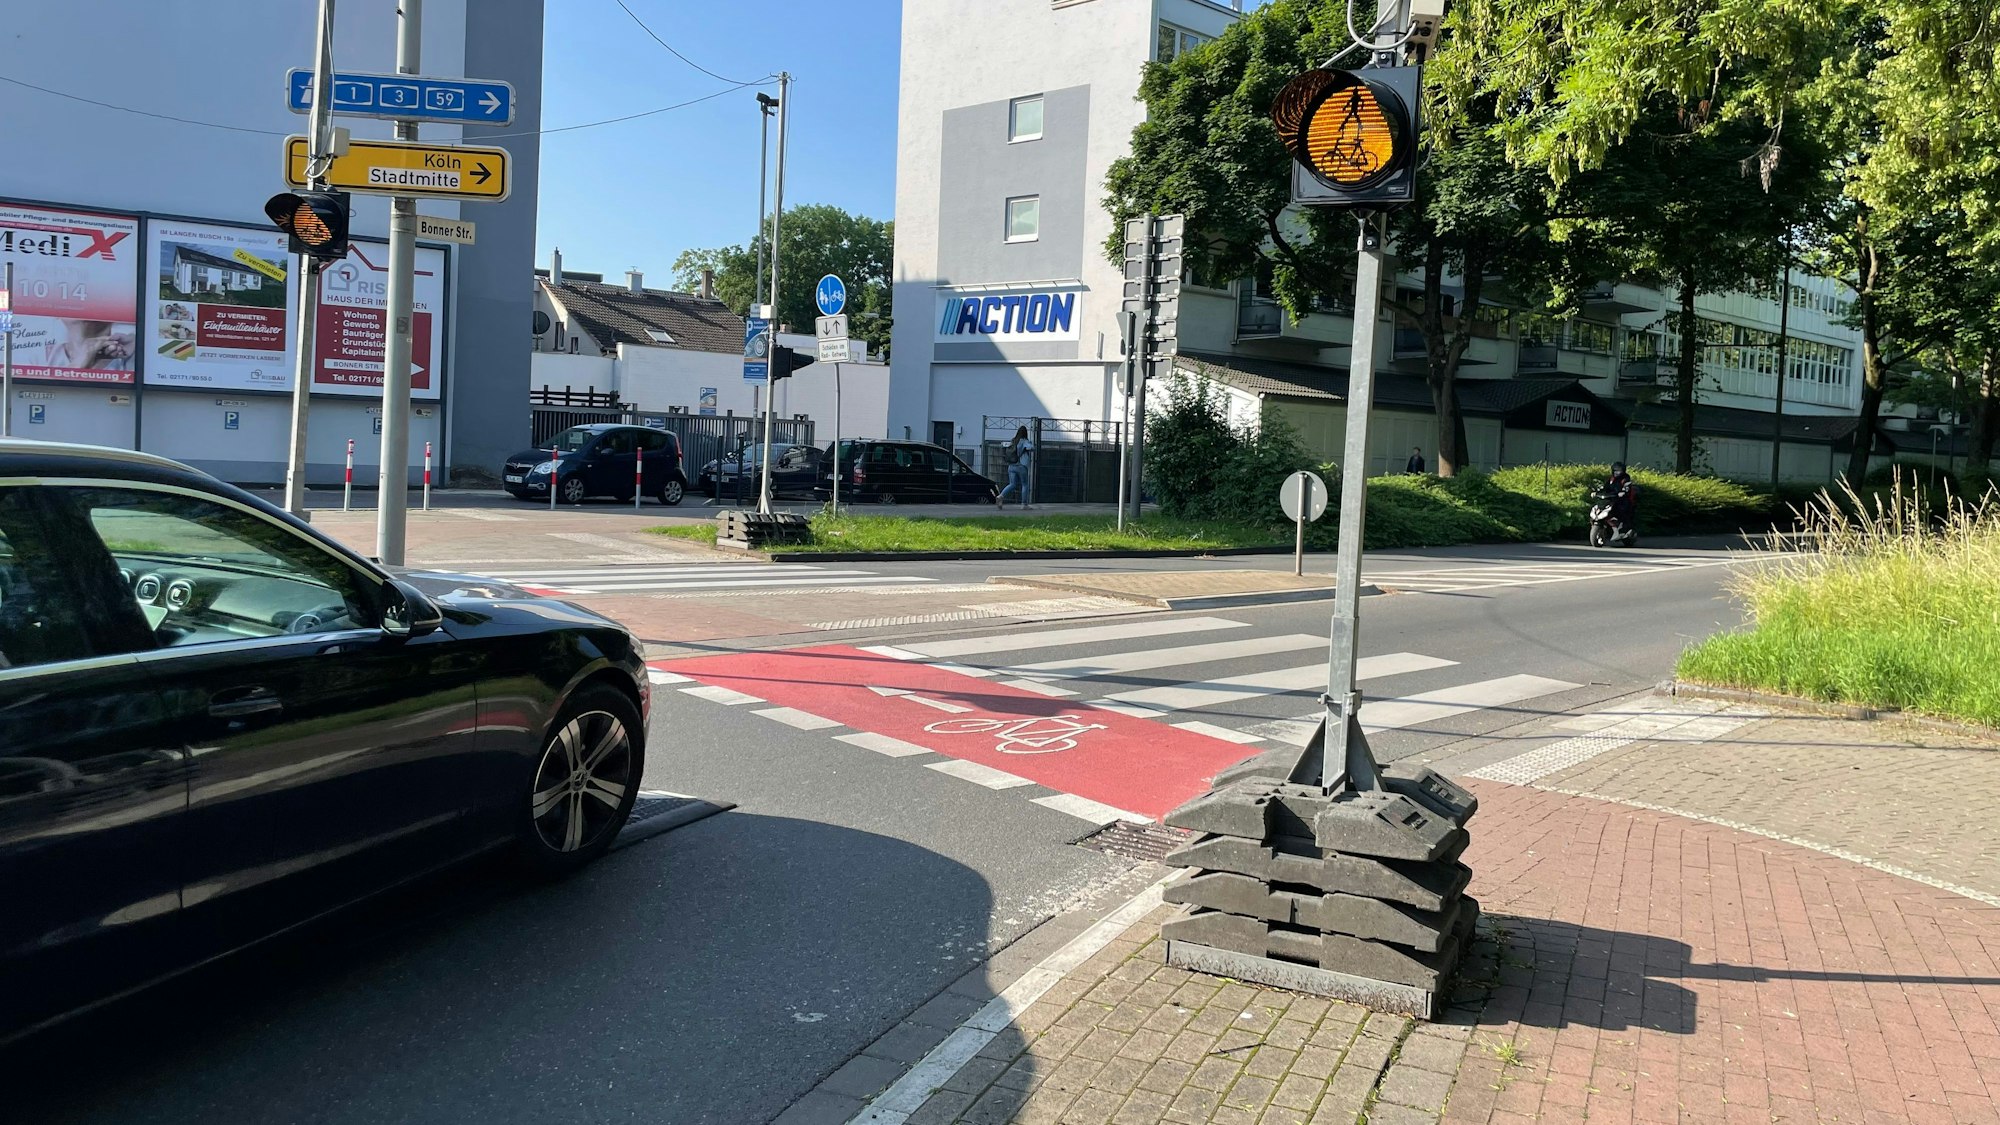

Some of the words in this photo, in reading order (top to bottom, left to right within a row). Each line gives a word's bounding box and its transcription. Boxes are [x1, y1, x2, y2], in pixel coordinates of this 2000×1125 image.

[350, 86, 356, 100] 1
[394, 89, 404, 103] 3
[435, 92, 455, 107] 59
[424, 153, 462, 169] Köln
[370, 168, 459, 187] Stadtmitte
[169, 230, 197, 238] LANGEN
[199, 232, 222, 240] BUSCH
[421, 221, 454, 237] Bonner
[456, 224, 472, 240] Str.
[236, 251, 247, 261] Zu
[248, 256, 282, 278] vermieten
[20, 278, 49, 298] 10
[57, 281, 88, 301] 14
[327, 294, 353, 303] HAUS
[355, 296, 373, 305] DER
[216, 311, 227, 319] ZU
[227, 312, 268, 321] VERMIETEN:
[343, 310, 378, 320] Wohnen
[955, 293, 1075, 334] ACTION
[203, 320, 283, 334] Einfamilienhäuser
[343, 319, 380, 330] Gewerbe
[746, 320, 753, 338] P
[342, 329, 384, 339] Bauträger
[342, 338, 387, 348] Grundstüc
[333, 361, 364, 370] BONNER
[27, 367, 50, 377] und
[54, 369, 119, 381] Betreuung
[332, 373, 347, 382] Tel.
[701, 388, 707, 396] P
[32, 405, 43, 418] P
[227, 412, 237, 424] P
[1553, 405, 1589, 424] ACTION
